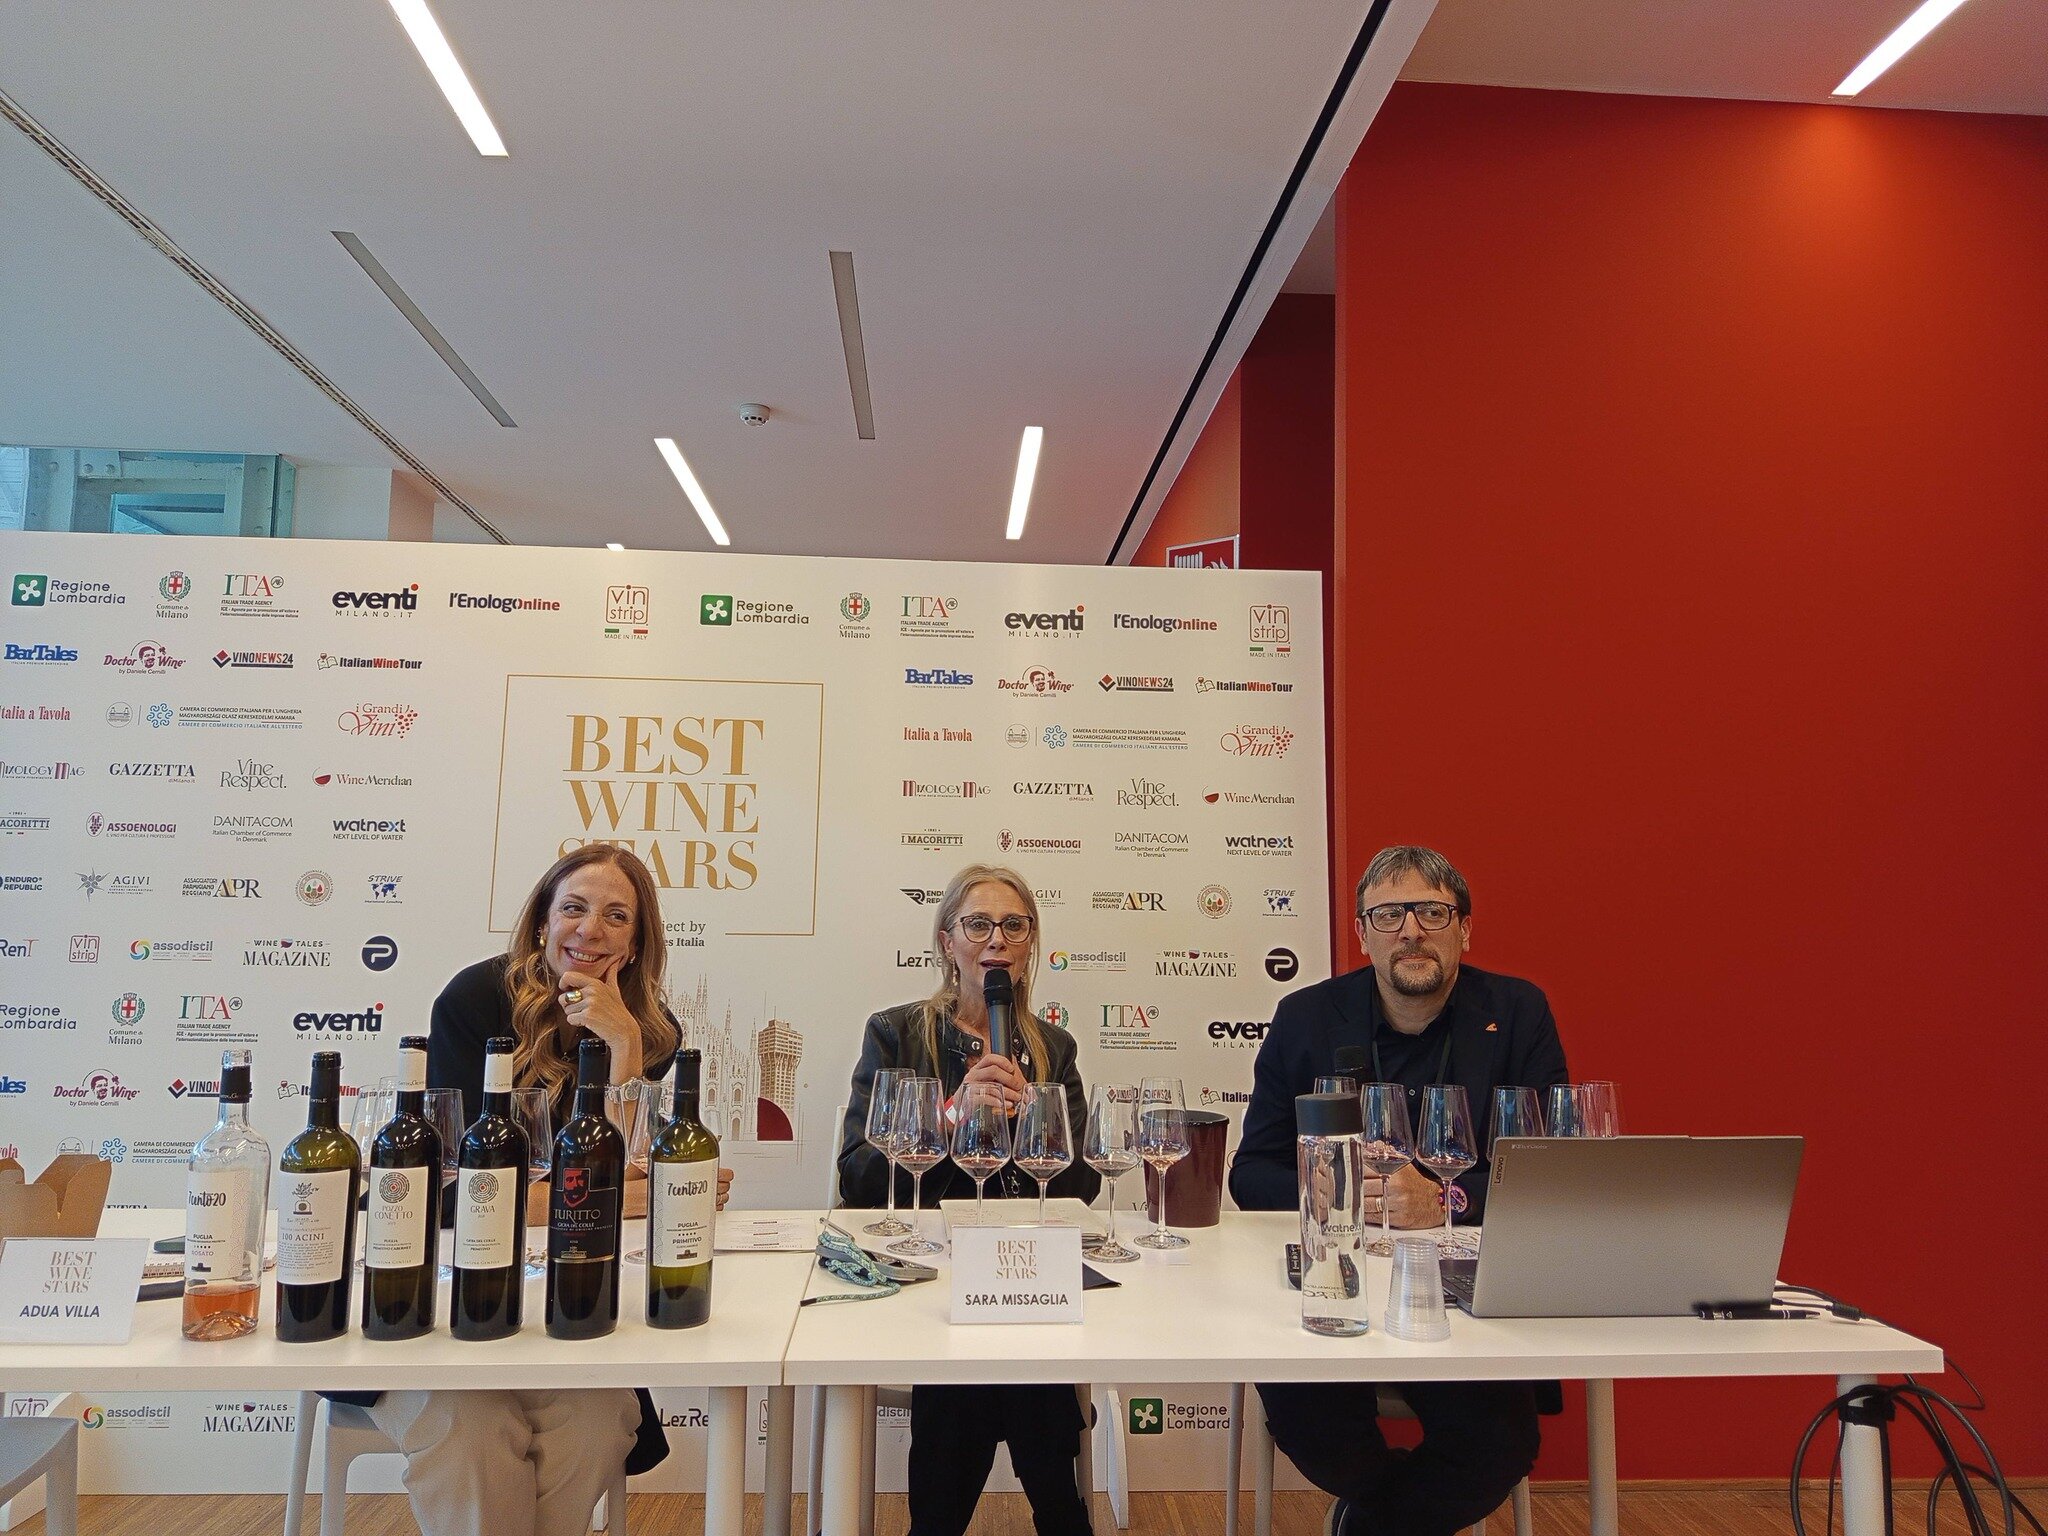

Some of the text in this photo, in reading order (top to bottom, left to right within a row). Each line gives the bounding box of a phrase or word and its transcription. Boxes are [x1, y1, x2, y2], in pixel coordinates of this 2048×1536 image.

[51, 580, 110, 594] Regione
[222, 574, 273, 597] ITA
[50, 592, 125, 605] Lombardia
[332, 583, 419, 610] eventi
[611, 584, 646, 605] vin
[736, 600, 794, 613] Regione
[900, 595, 949, 618] ITA
[155, 610, 189, 619] Milano
[335, 610, 413, 618] MILANO.IT
[609, 606, 645, 624] strip
[736, 612, 810, 624] Lombardia
[1004, 604, 1085, 631] eventi
[1253, 604, 1287, 624] vin
[839, 630, 871, 639] Milano
[1253, 625, 1287, 642] strip
[4, 644, 78, 662] BarTales
[232, 651, 294, 664] VINONEWS24
[103, 654, 184, 669] Doctor Wine
[339, 657, 423, 670] ItalianWineTour
[905, 668, 973, 685] BarTales
[1116, 676, 1174, 688] VINONEWS24
[998, 679, 1073, 693] Doctor Wine
[1216, 681, 1294, 693] ItalianWineTour
[0, 705, 71, 721] talia a Tavola
[362, 703, 403, 714] Grandi
[338, 711, 397, 736] Vini
[903, 727, 973, 742] Italia a Tavola
[562, 714, 765, 776] BEST
[109, 763, 195, 777] GAZZETTA
[237, 758, 274, 776] Vine
[219, 771, 287, 792] Respect.
[336, 773, 412, 786] Wine Meridian
[1130, 777, 1166, 795] Vine
[1013, 782, 1094, 796] GAZZETTA
[1117, 789, 1180, 809] Respect.
[1224, 792, 1295, 804] Wine Meridian
[562, 779, 760, 833] WINE
[107, 823, 177, 833] ASSOENOLOGI
[213, 815, 293, 828] DANITACOM
[332, 818, 407, 832] watnext
[907, 835, 963, 845] MACORITTI
[1016, 839, 1081, 849] ASSOENOLOGI
[1114, 832, 1189, 844] DANITACOM
[1225, 835, 1294, 849] watnext
[557, 837, 759, 891] ARS
[112, 875, 150, 885] AGIVI
[367, 874, 403, 883] STRIVE
[212, 878, 262, 899] APR
[1262, 889, 1297, 897] STRIVE
[1121, 892, 1167, 912] APR
[690, 919, 706, 935] by
[73, 934, 99, 949] vin
[153, 940, 213, 951] assodistil
[253, 939, 278, 947] WINE
[676, 937, 705, 947] Italia
[71, 949, 96, 963] strip
[243, 951, 331, 967] MAGAZINE
[1070, 951, 1126, 962] assodistil
[1163, 950, 1229, 959] WINE TALES
[1155, 961, 1237, 978] MAGAZINE
[178, 996, 231, 1020] ITA
[293, 1002, 384, 1032] eventi
[1100, 1004, 1151, 1029] ITA
[108, 1035, 143, 1046] Milano
[296, 1033, 378, 1041] MILANO.IT
[53, 1085, 138, 1101] Doctor Wine
[1494, 1156, 1504, 1185] Lenovo
[553, 1208, 601, 1223] TURITTO
[282, 1232, 325, 1242] 100 ACINI
[672, 1236, 702, 1245] PRIMITIVO
[997, 1240, 1037, 1254] BEST
[50, 1251, 97, 1266] BEST
[997, 1254, 1037, 1267] WINE
[49, 1266, 93, 1280] WINE
[995, 1267, 1038, 1280] STARS
[42, 1280, 90, 1293] STARS
[965, 1293, 1069, 1306] SARA MISSAGLIA
[19, 1305, 101, 1318] ADUA VILLA
[107, 1405, 171, 1418] assodistil
[215, 1403, 288, 1411] WINE TALES
[1167, 1403, 1228, 1418] Regione
[203, 1415, 296, 1433] MAGAZINE
[1167, 1417, 1231, 1430] Lombard
